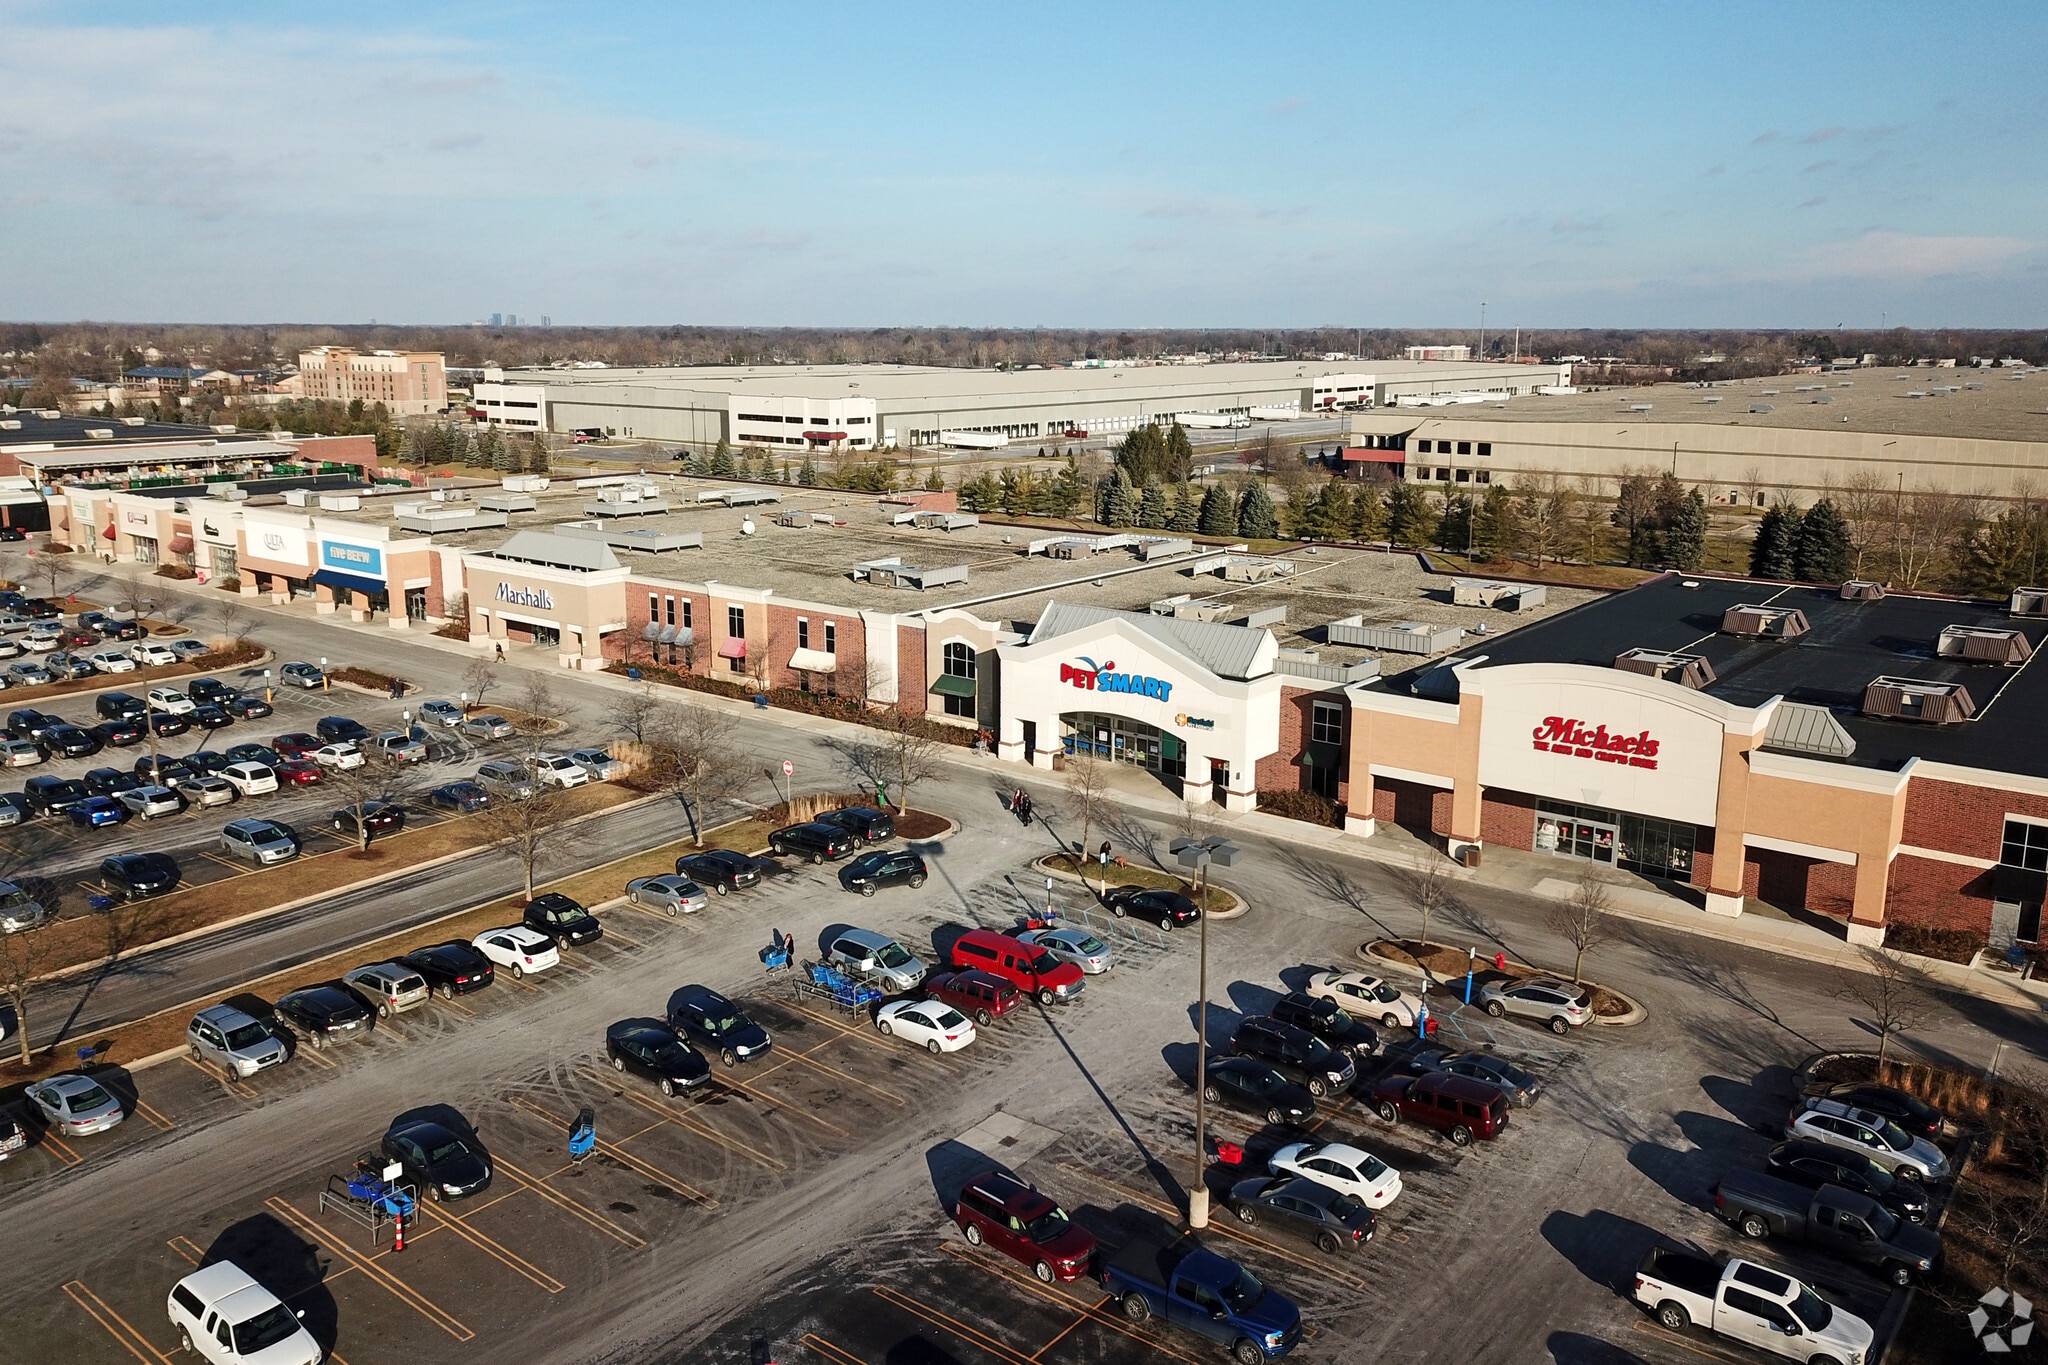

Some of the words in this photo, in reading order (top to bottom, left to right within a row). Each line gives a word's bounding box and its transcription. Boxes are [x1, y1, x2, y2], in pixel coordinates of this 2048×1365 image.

[263, 532, 287, 551] ULTA
[495, 582, 552, 610] Marshalls
[1060, 663, 1172, 702] PETSMART
[1532, 716, 1660, 757] Michaels
[1532, 740, 1550, 751] THE
[1550, 743, 1573, 755] ARTS
[1574, 747, 1593, 758] AND
[1594, 751, 1628, 764] CRAFTS
[1628, 756, 1658, 770] STORE
